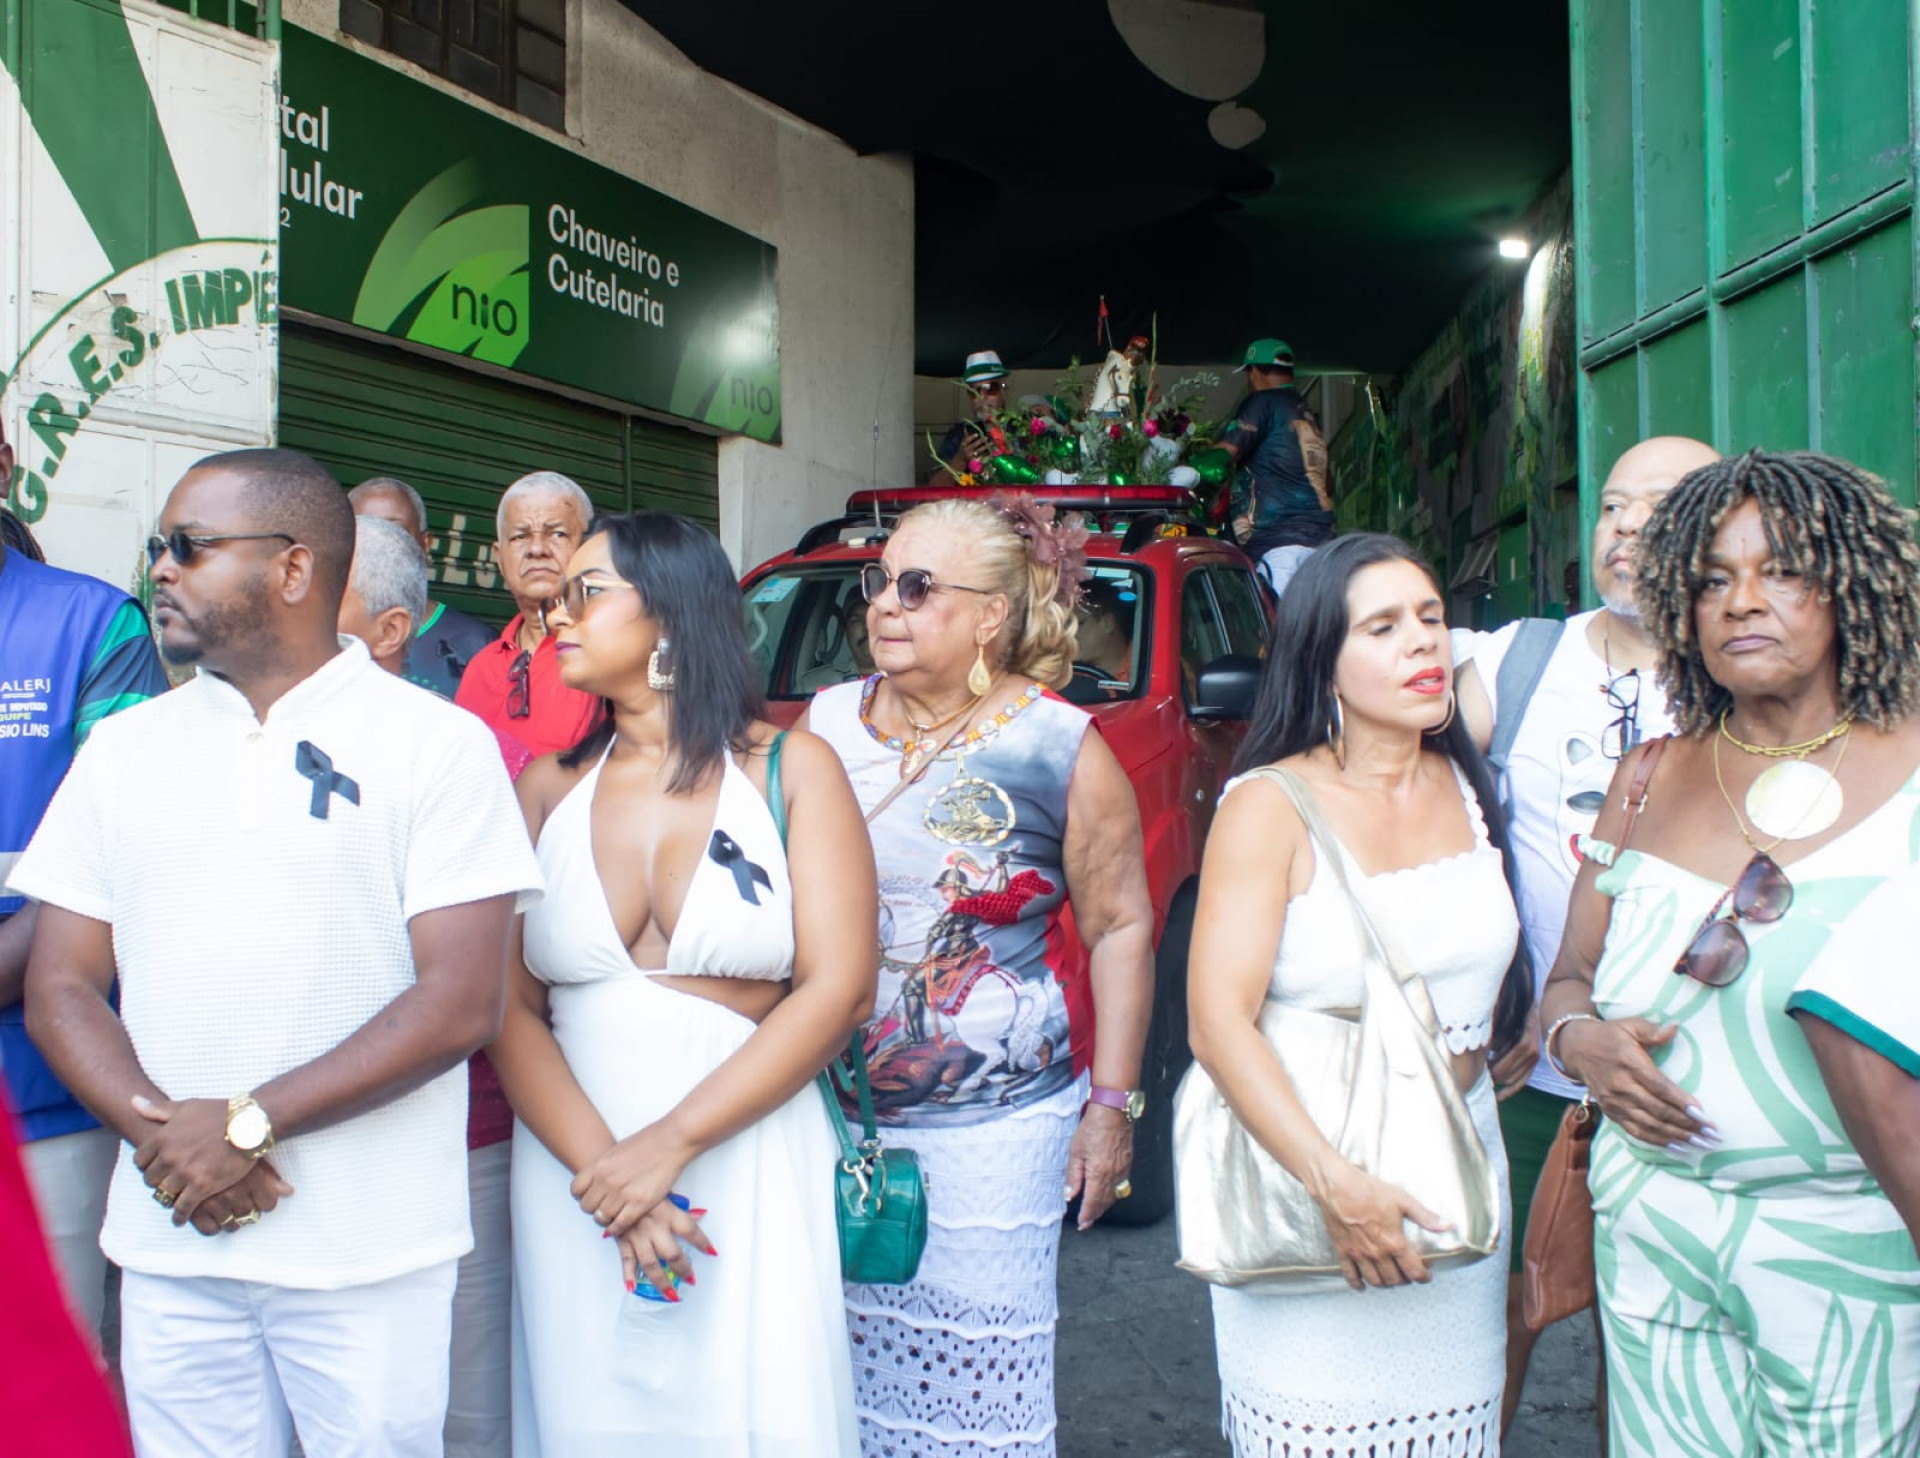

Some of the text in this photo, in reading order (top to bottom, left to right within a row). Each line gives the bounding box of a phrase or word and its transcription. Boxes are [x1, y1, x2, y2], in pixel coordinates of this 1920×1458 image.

[548, 204, 680, 287] Chaveiro e
[452, 282, 518, 336] nio
[548, 253, 665, 327] Cutelaria
[730, 377, 774, 416] nio
[0, 678, 51, 693] ALERJ
[22, 722, 50, 738] LINS
